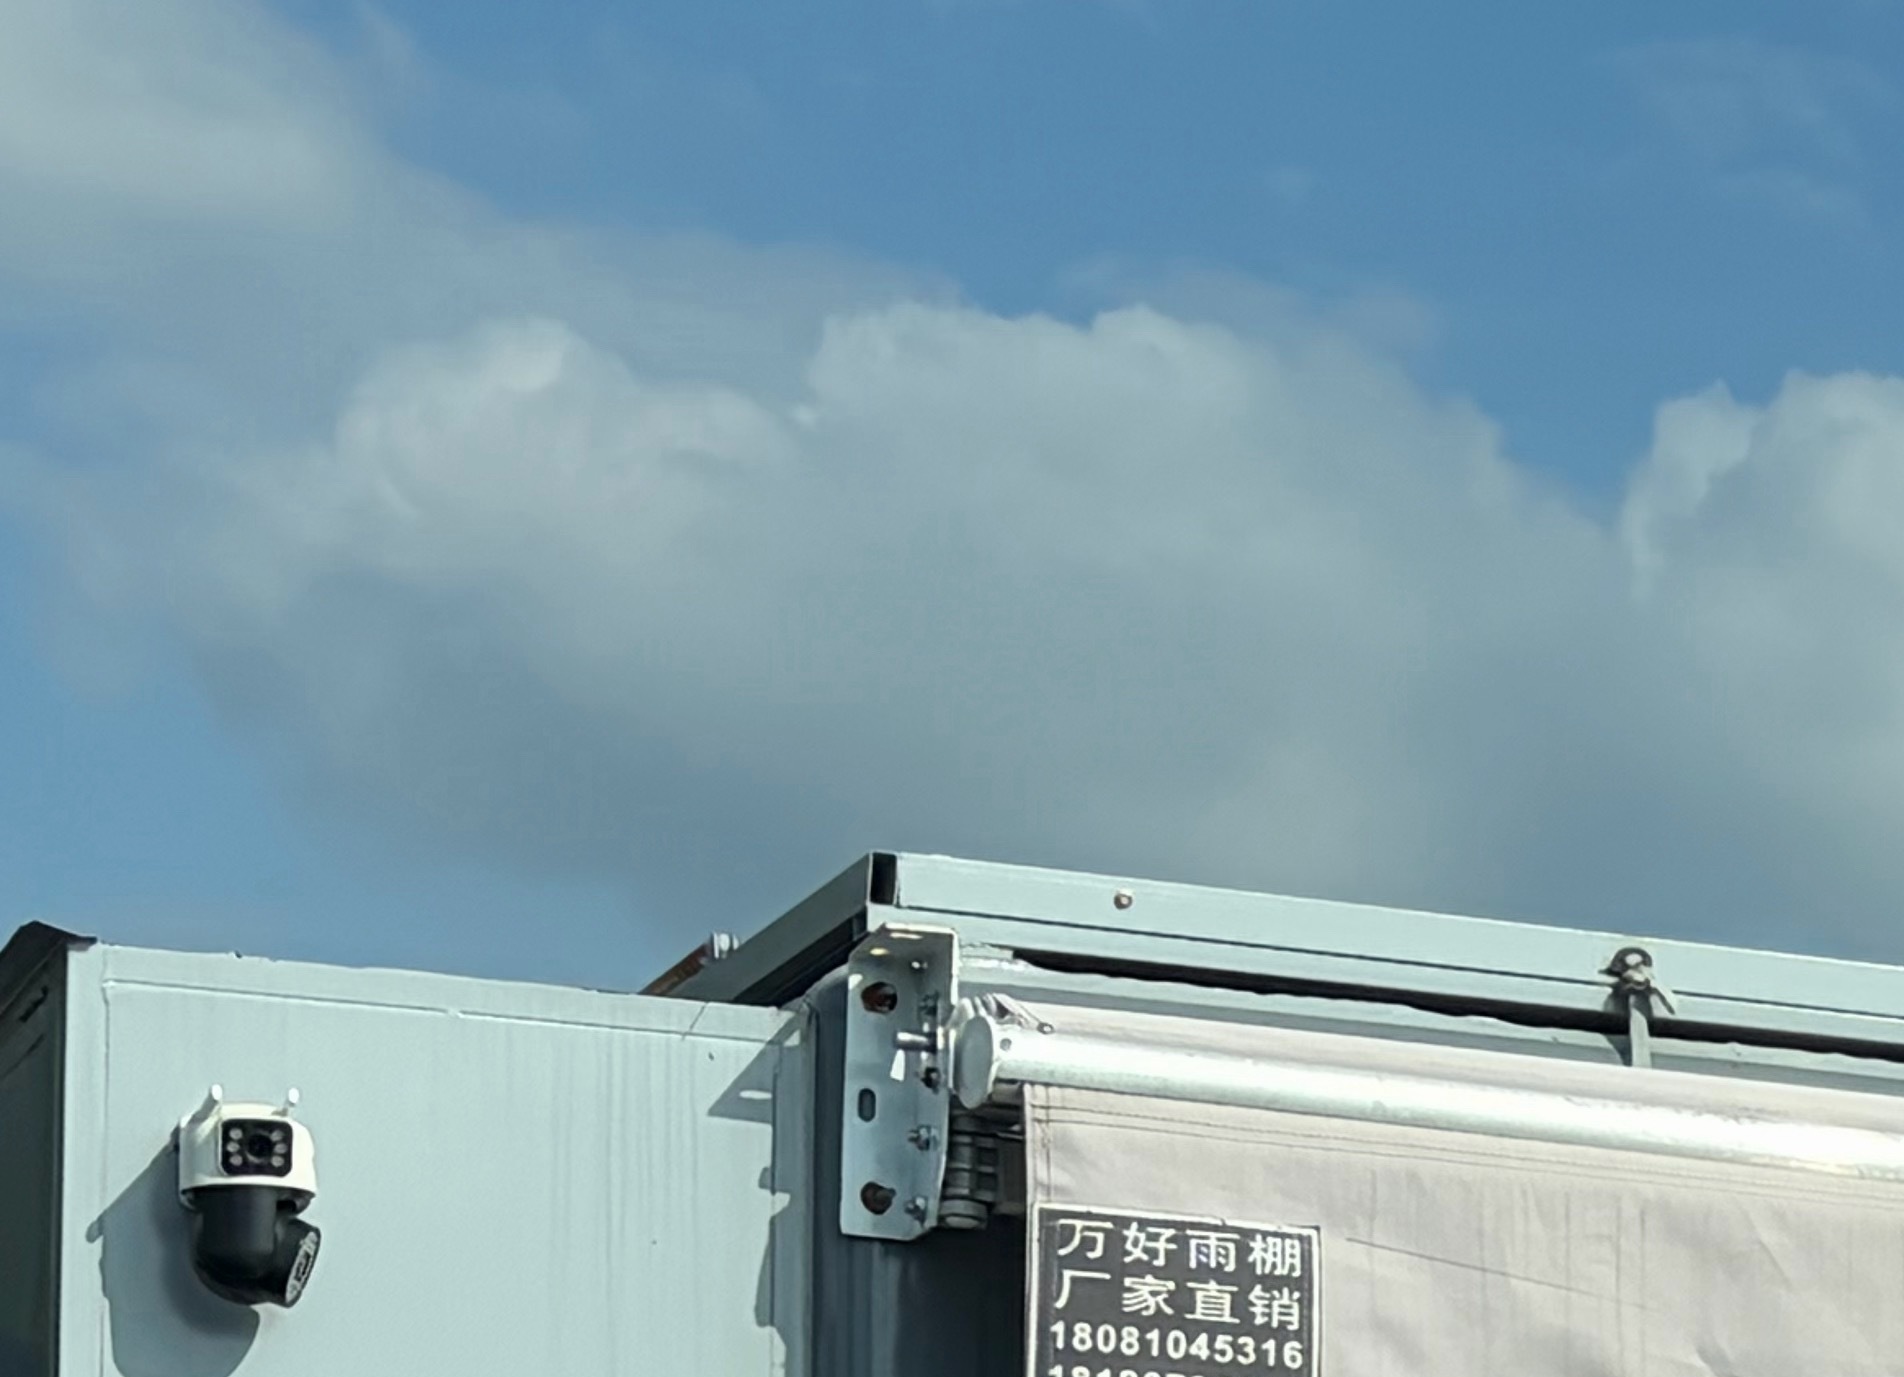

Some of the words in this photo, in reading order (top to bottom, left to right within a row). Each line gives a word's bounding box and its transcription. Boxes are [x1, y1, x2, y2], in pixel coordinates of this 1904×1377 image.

[1057, 1217, 1302, 1278] 万好雨棚
[1054, 1269, 1301, 1331] 厂家直销
[1050, 1320, 1303, 1369] 18081045316
